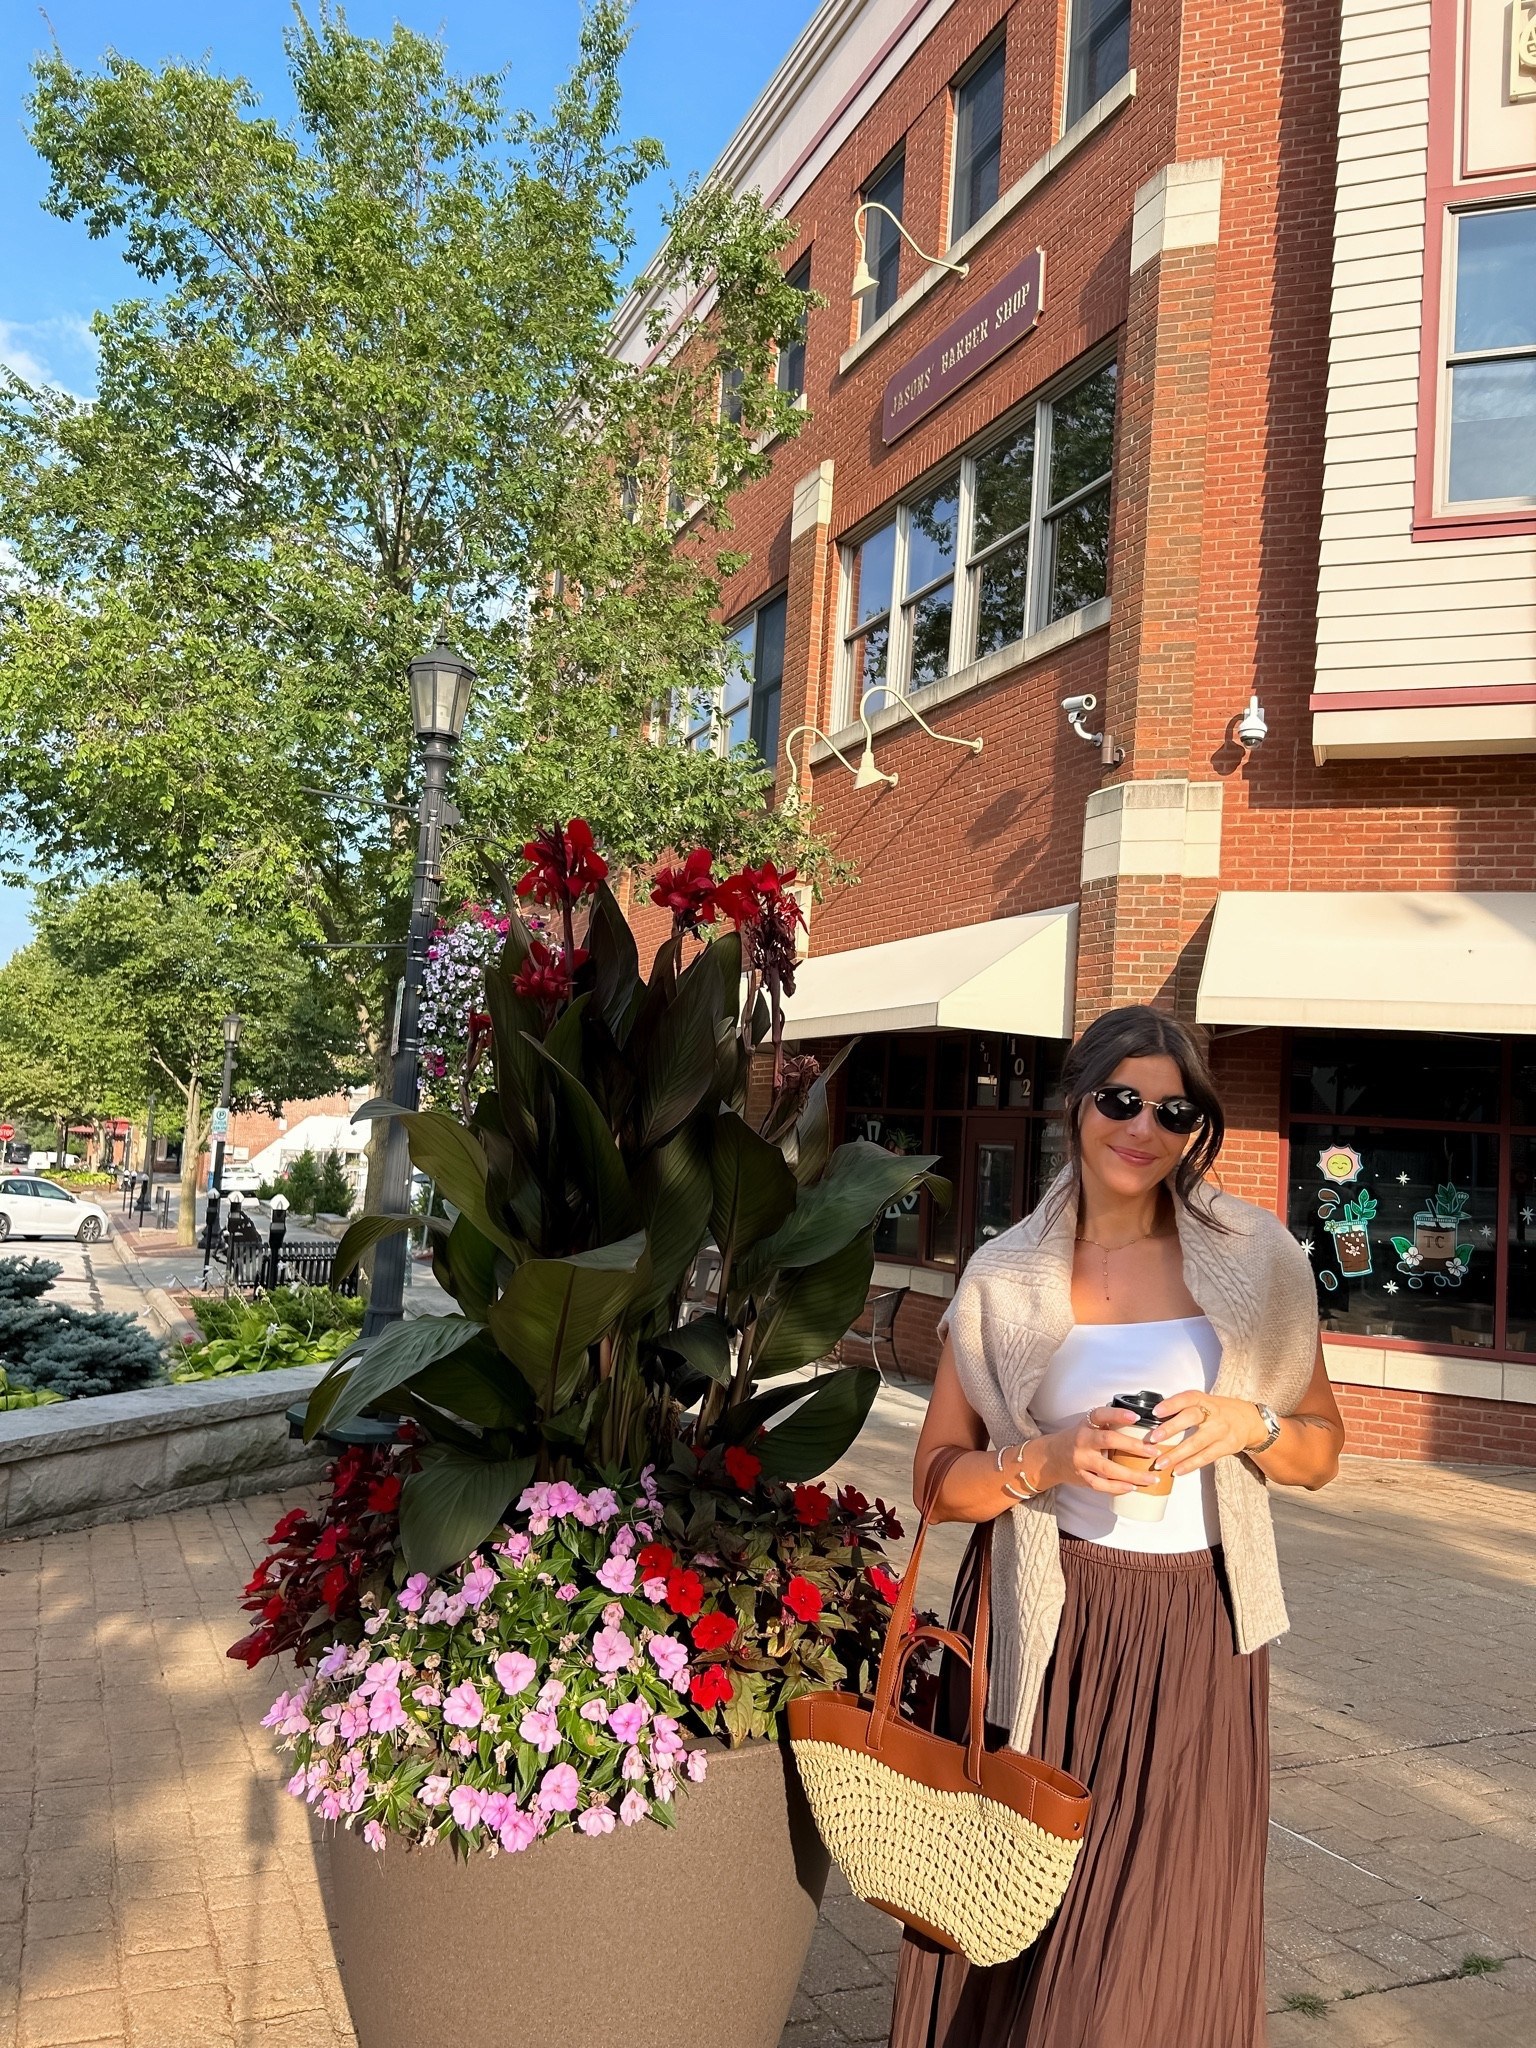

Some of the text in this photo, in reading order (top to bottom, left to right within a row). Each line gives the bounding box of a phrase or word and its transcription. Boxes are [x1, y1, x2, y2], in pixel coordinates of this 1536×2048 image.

[940, 318, 990, 376] BARBER
[995, 281, 1031, 331] SHOP
[1010, 1038, 1031, 1097] 102
[1423, 1235, 1445, 1249] TC
